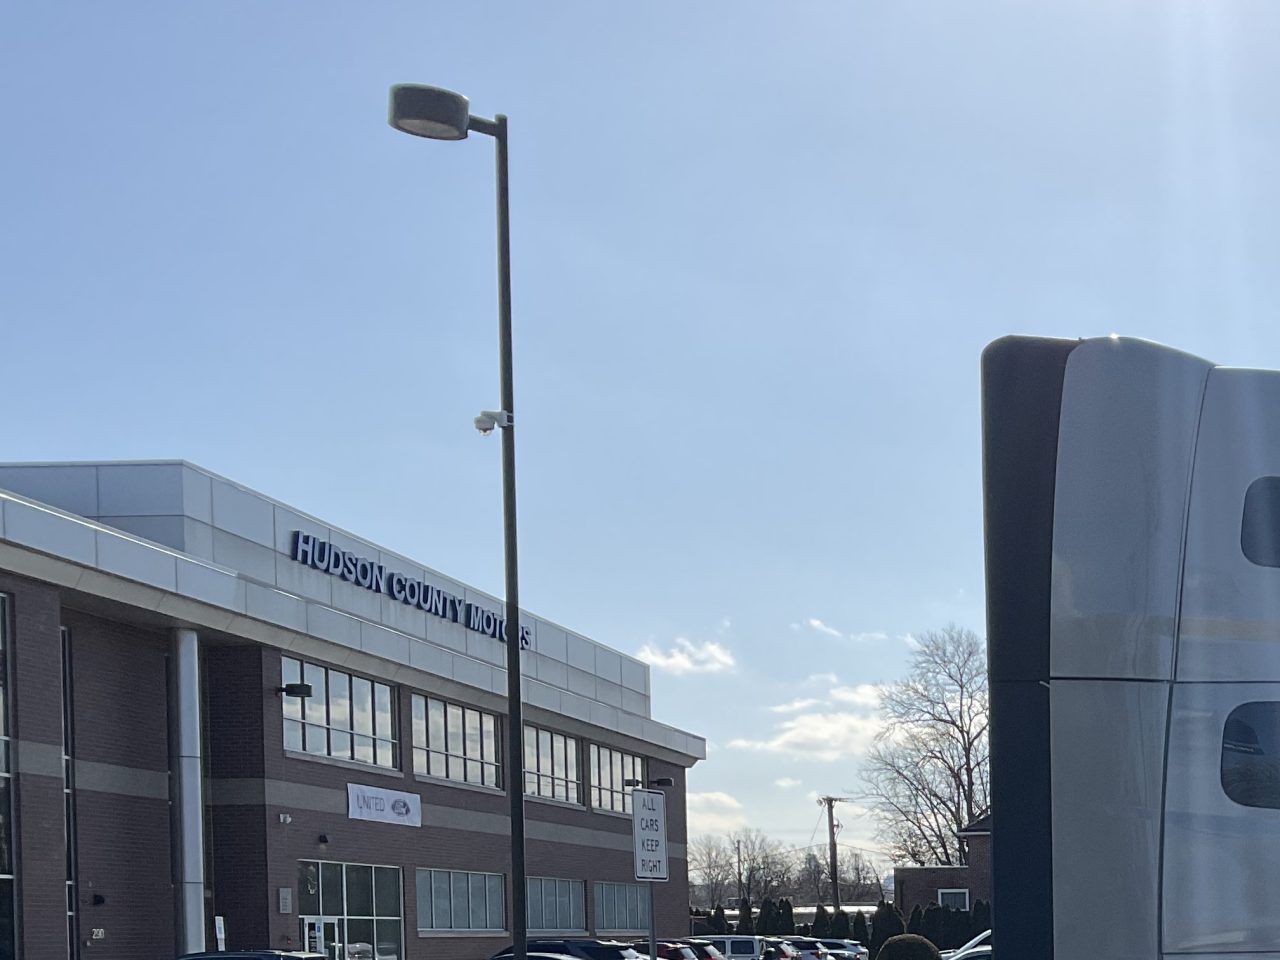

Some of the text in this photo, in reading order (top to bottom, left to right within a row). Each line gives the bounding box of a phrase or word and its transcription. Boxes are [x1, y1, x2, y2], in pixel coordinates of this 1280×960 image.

[292, 530, 386, 593] HUDSON
[389, 572, 466, 624] COUNTY
[356, 792, 386, 812] UNITED
[642, 797, 656, 811] ALL
[640, 818, 659, 832] CARS
[641, 838, 660, 852] KEEP
[641, 859, 661, 873] RIGHT
